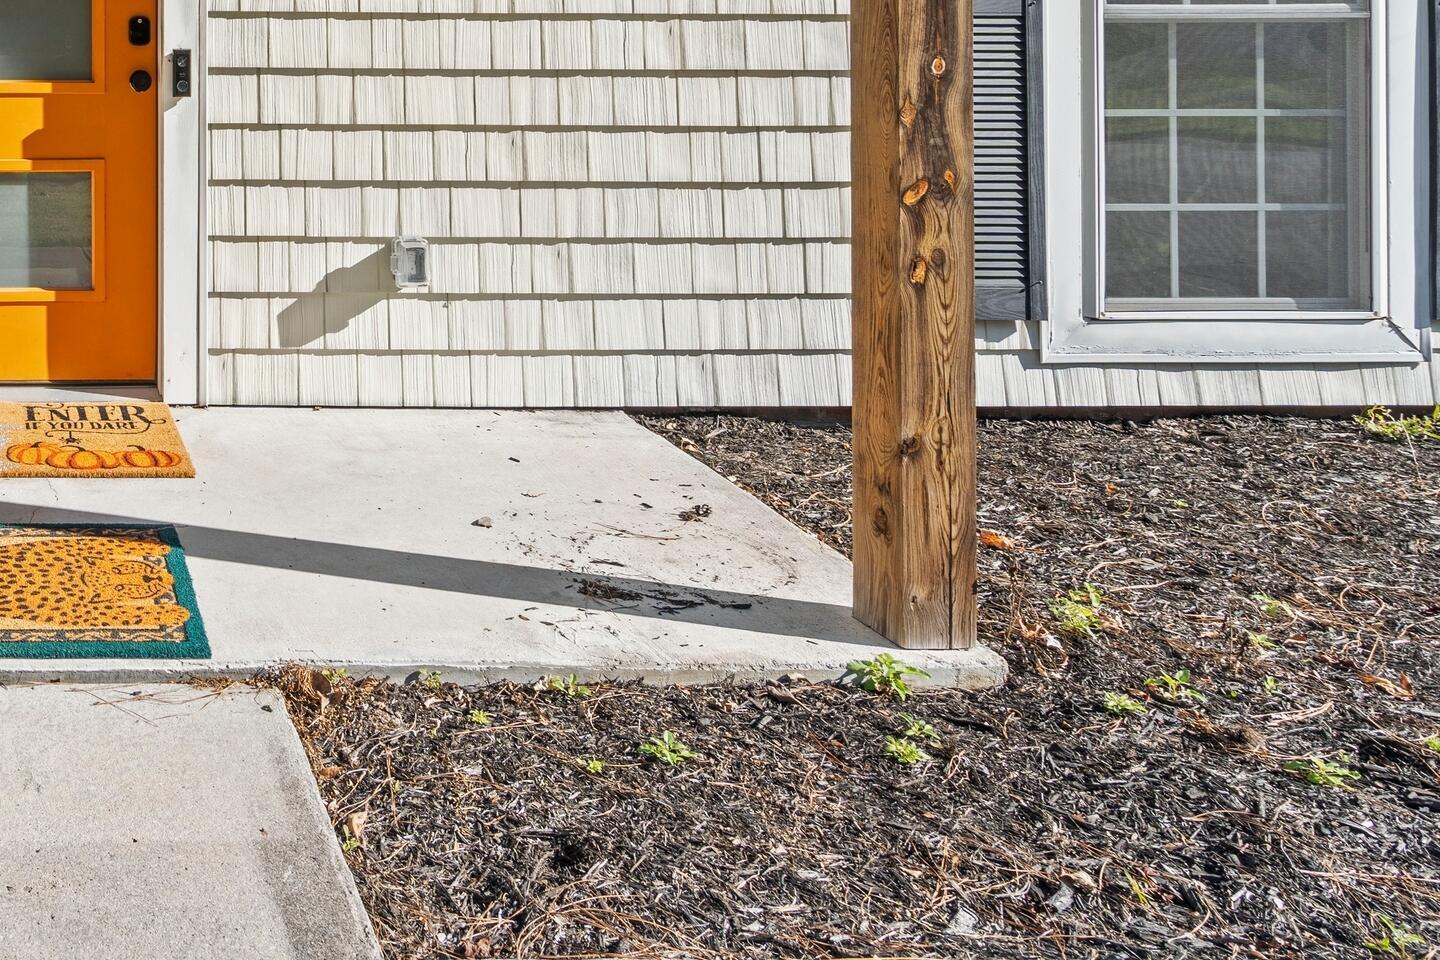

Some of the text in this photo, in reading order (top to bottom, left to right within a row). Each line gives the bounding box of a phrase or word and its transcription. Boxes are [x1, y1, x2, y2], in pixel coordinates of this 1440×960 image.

[23, 404, 151, 423] ENTER
[24, 421, 140, 430] IF YOU DARE
